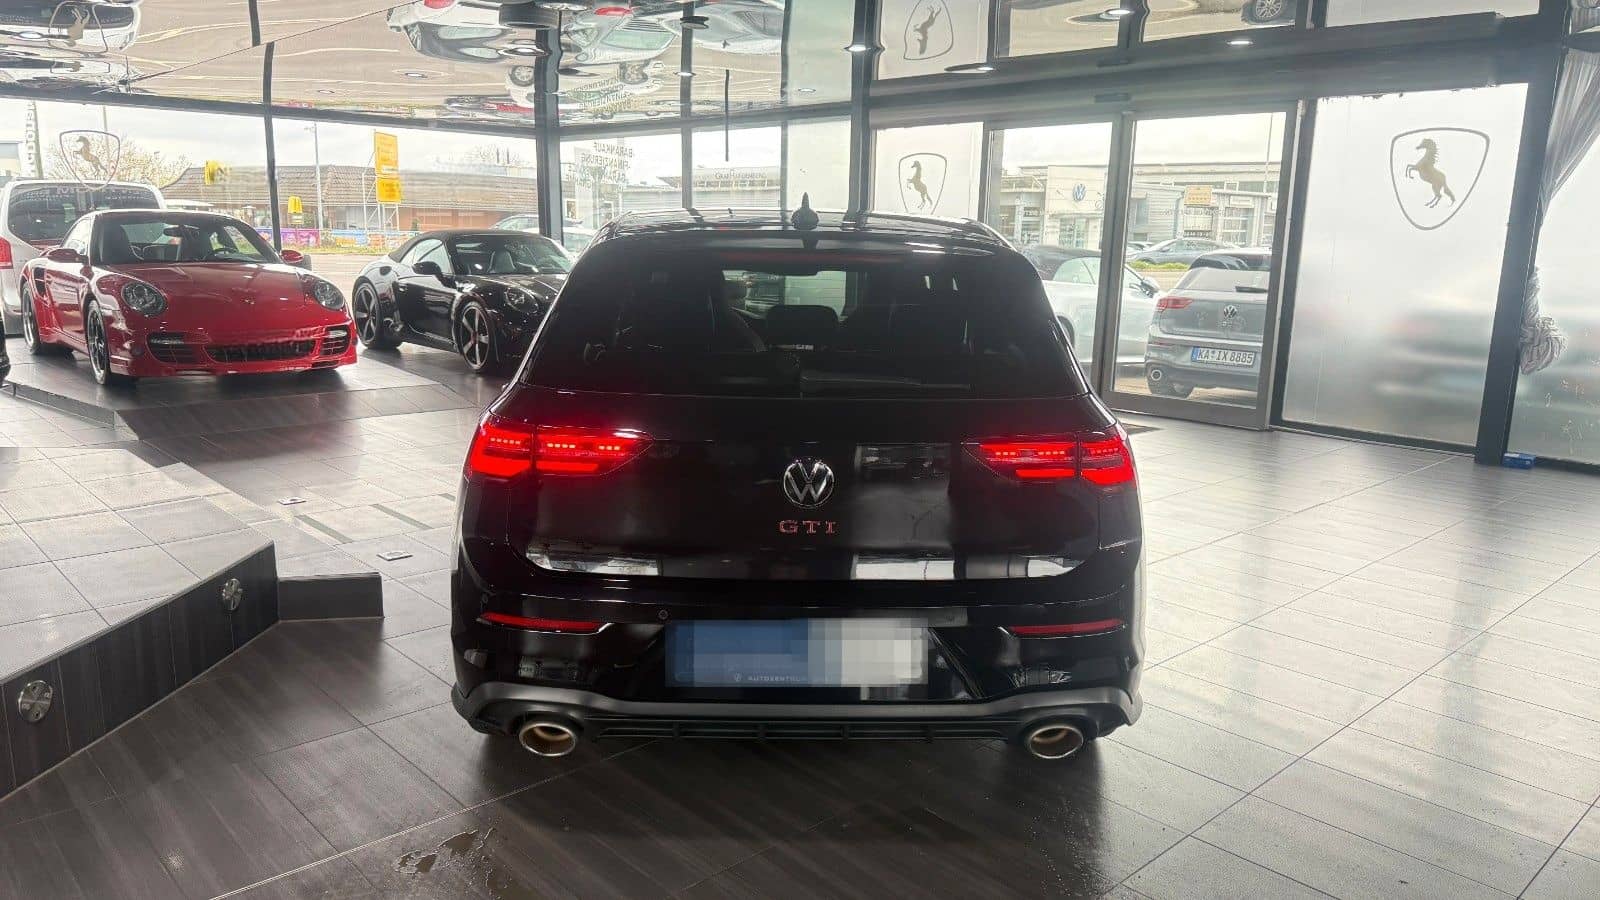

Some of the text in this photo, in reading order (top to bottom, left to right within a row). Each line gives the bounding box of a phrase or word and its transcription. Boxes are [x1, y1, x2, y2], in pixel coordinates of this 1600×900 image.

[1198, 348, 1254, 364] KA IX 8885
[778, 519, 837, 534] GTI
